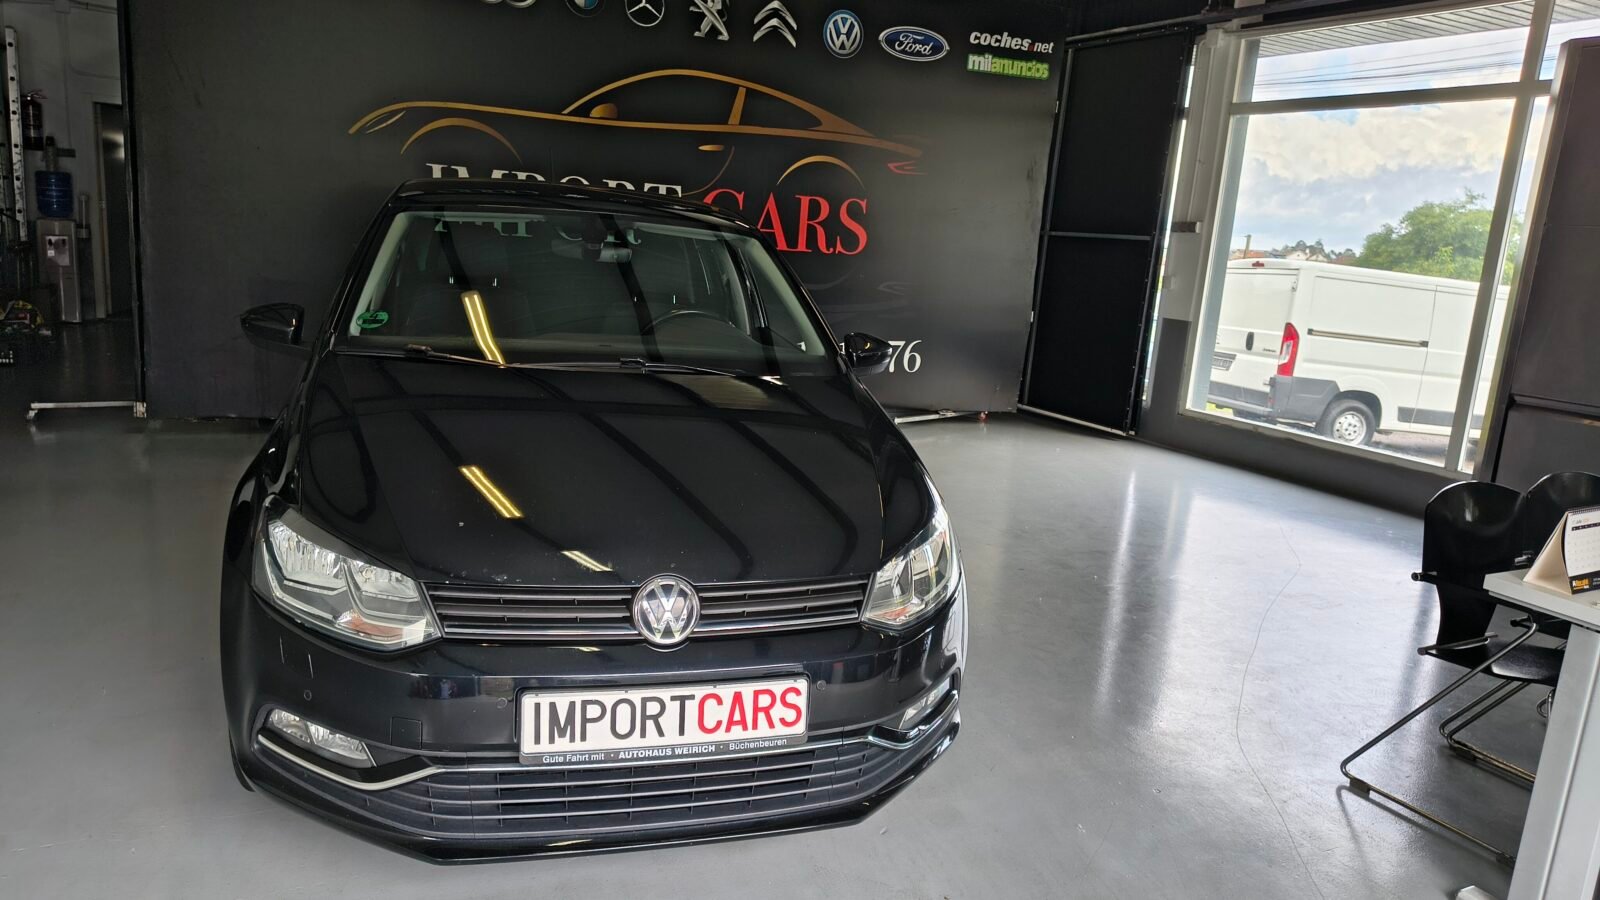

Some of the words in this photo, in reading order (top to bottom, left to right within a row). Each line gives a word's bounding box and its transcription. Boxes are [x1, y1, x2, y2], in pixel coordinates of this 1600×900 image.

[894, 32, 934, 56] Ford
[969, 31, 1054, 53] coches.net
[967, 53, 1049, 79] milanuncios
[542, 755, 564, 763] Gute
[566, 754, 589, 763] Fahrt
[591, 753, 605, 761] mit
[618, 748, 672, 760] AUTOHAUS
[674, 744, 716, 755] WEIRICH
[729, 738, 788, 751] Büchenbeuren
